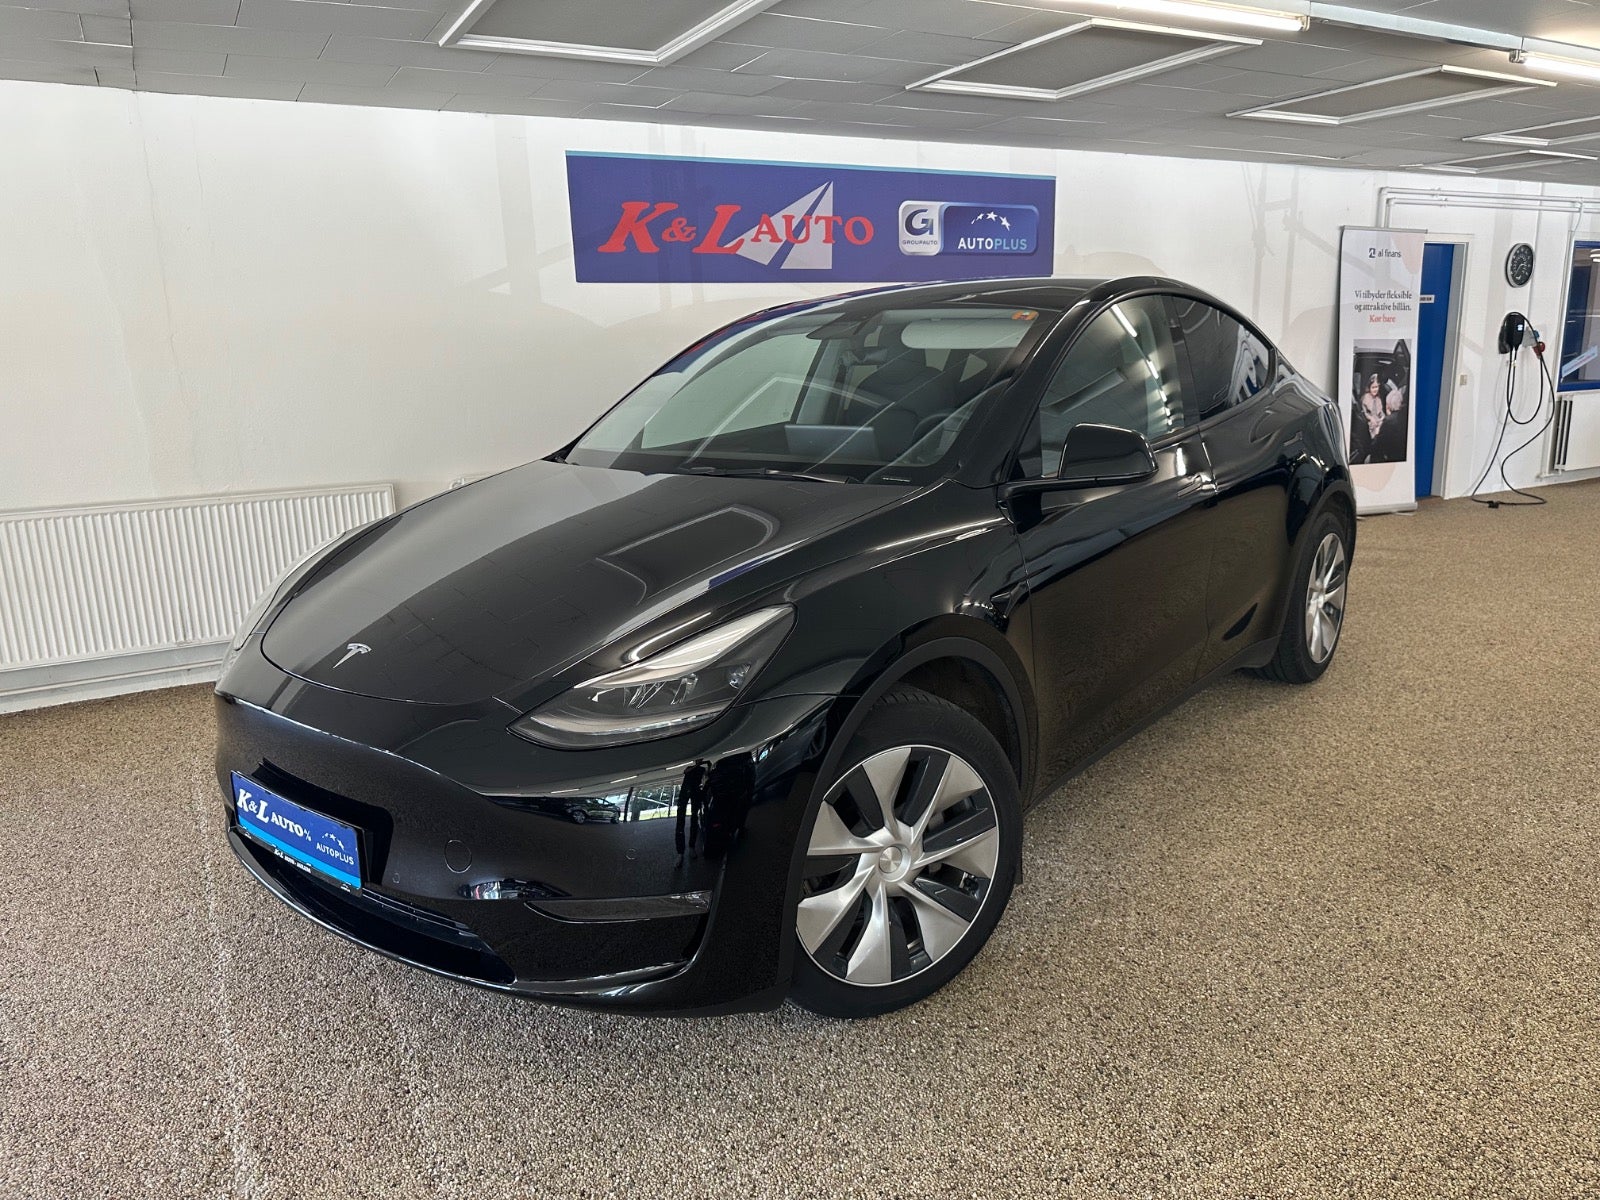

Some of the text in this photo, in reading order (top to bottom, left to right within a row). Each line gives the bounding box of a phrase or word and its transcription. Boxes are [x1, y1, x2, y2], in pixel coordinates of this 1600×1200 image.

[750, 213, 875, 245] AUTO
[957, 237, 1028, 250] AUTOPLUS
[1354, 290, 1362, 299] Vi
[1363, 290, 1386, 301] tilbyder
[1386, 290, 1412, 299] fleksible
[1354, 304, 1362, 312] og
[1363, 302, 1391, 311] attraktive
[316, 842, 355, 866] AUTOPLUS
